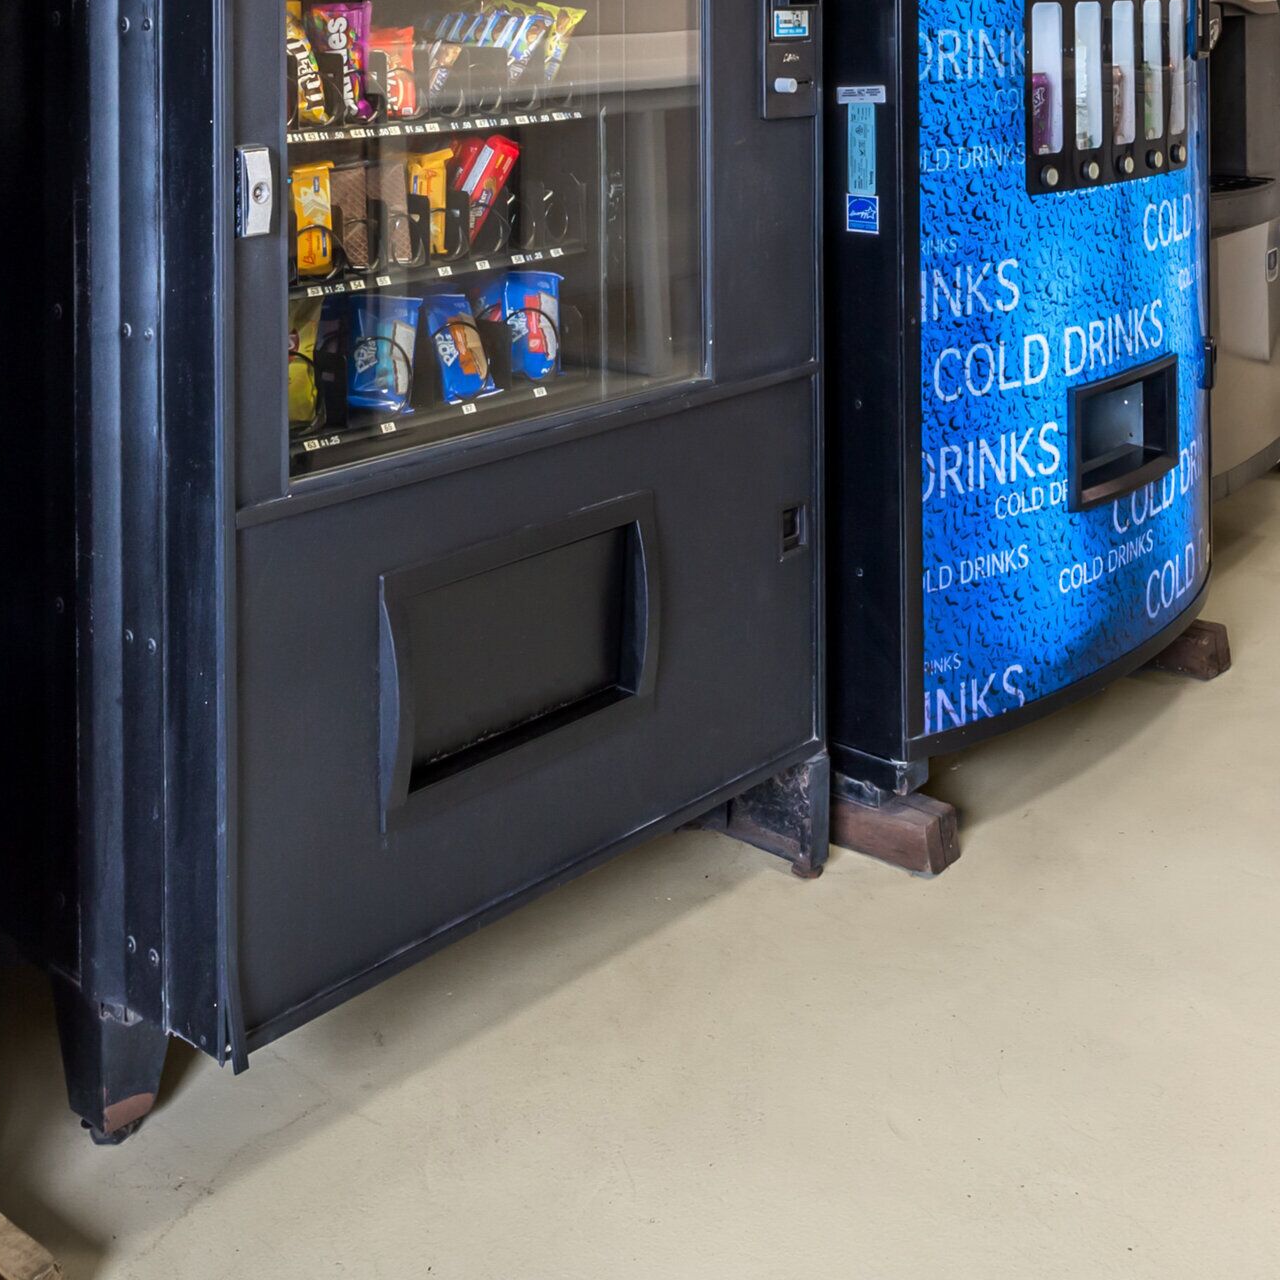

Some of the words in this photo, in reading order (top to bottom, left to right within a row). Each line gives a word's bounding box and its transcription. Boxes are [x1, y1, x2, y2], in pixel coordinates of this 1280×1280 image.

[921, 148, 950, 172] LD
[958, 141, 1026, 170] DRINKS
[1143, 192, 1193, 252] COLD
[933, 333, 1050, 403] COLD
[1064, 298, 1163, 377] DRINKS
[995, 486, 1045, 520] COLD
[922, 565, 953, 594] LD
[960, 544, 1029, 585] DRINKS
[1058, 556, 1104, 594] COLD
[1108, 528, 1154, 574] DRINKS
[1145, 542, 1195, 619] COLD
